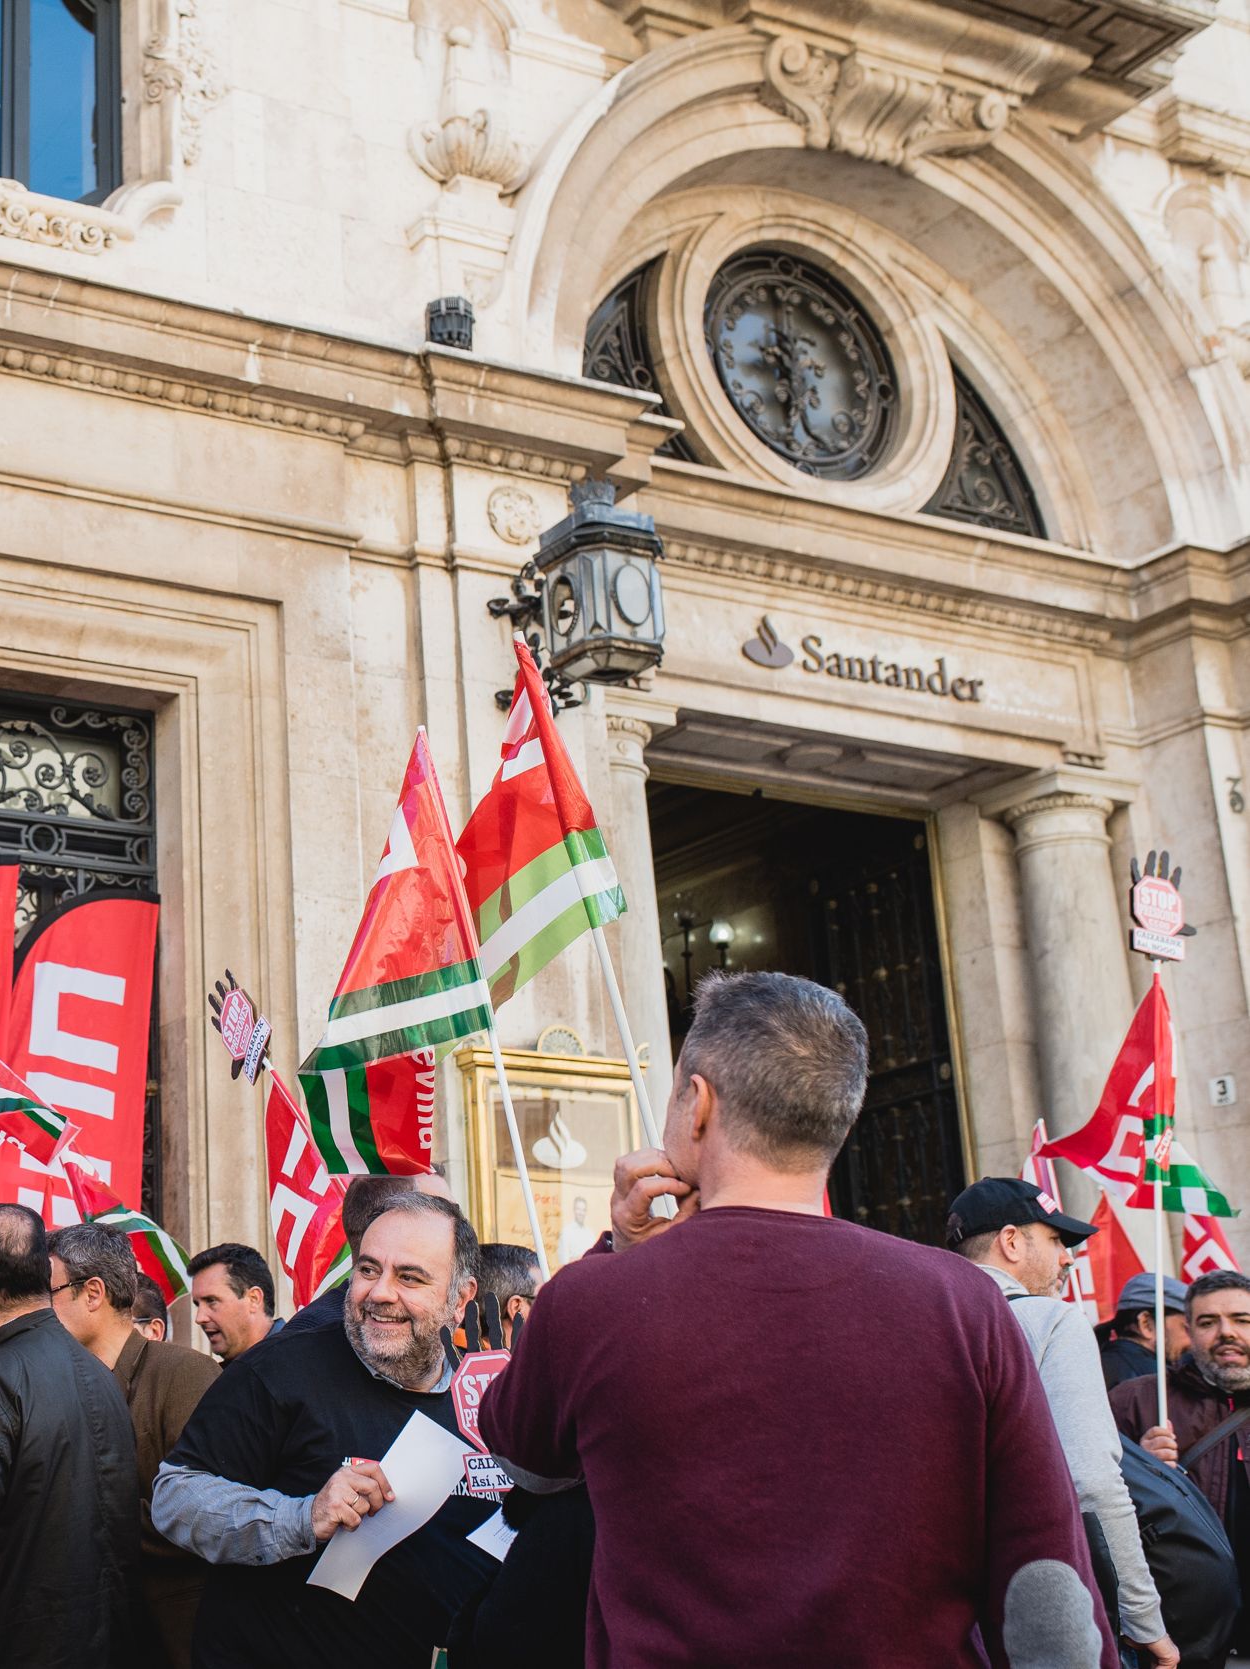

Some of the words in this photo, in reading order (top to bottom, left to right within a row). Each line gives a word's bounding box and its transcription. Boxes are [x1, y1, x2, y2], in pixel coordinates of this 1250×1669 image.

[801, 634, 984, 703] Santander
[1140, 886, 1177, 911] STOP
[223, 994, 241, 1041] STOP
[1216, 1079, 1227, 1096] 3
